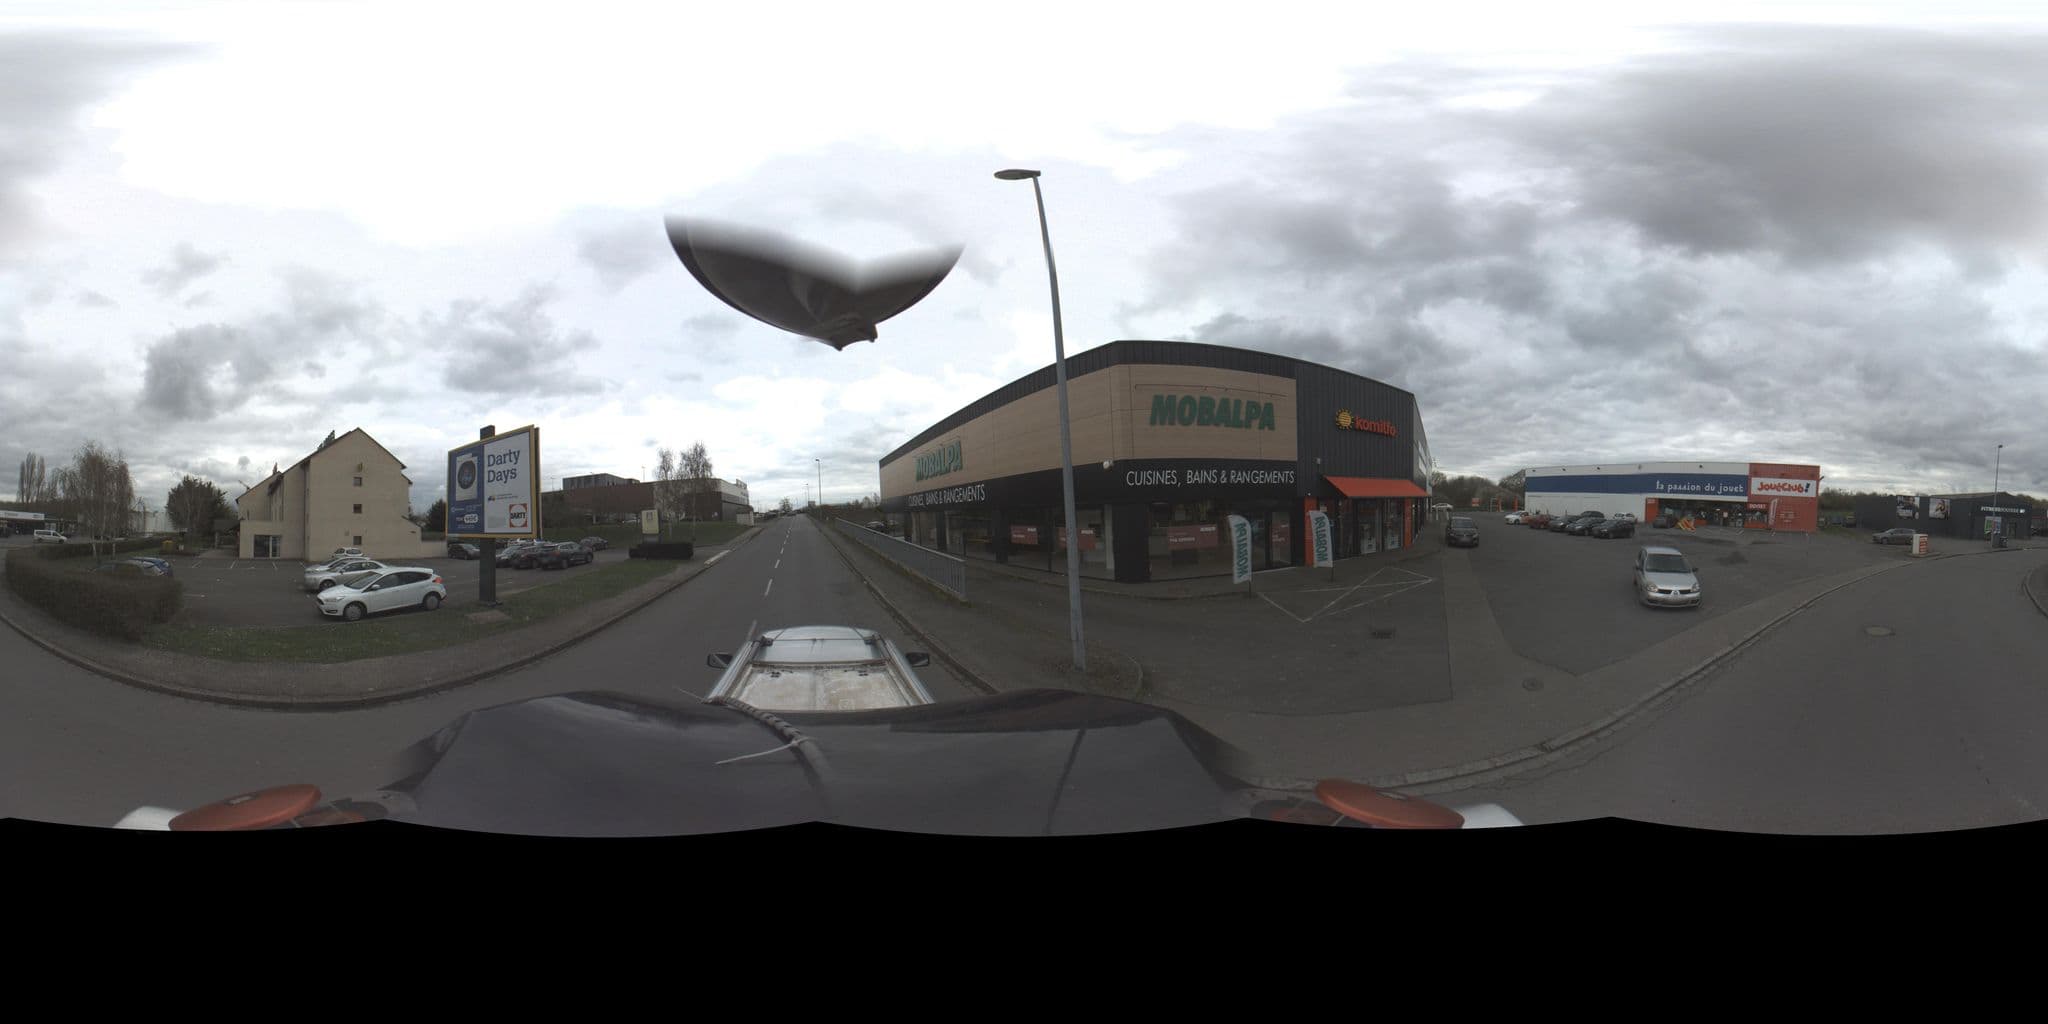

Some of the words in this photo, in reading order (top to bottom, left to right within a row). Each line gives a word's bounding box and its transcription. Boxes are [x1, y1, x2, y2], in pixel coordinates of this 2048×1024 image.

[1150, 394, 1276, 430] MOBALPA
[487, 449, 520, 467] Darty
[916, 441, 962, 481] MOBALPA
[487, 468, 517, 483] Days
[1126, 469, 1181, 487] CUISINES,
[1186, 469, 1218, 485] BAINS
[1220, 470, 1227, 483] &
[1229, 469, 1295, 485] RANGEMENTS
[944, 484, 986, 505] RANGEMENTS
[1656, 479, 1664, 490] la
[1668, 482, 1701, 493] passion
[1704, 483, 1716, 491] du
[1717, 483, 1744, 494] jouet
